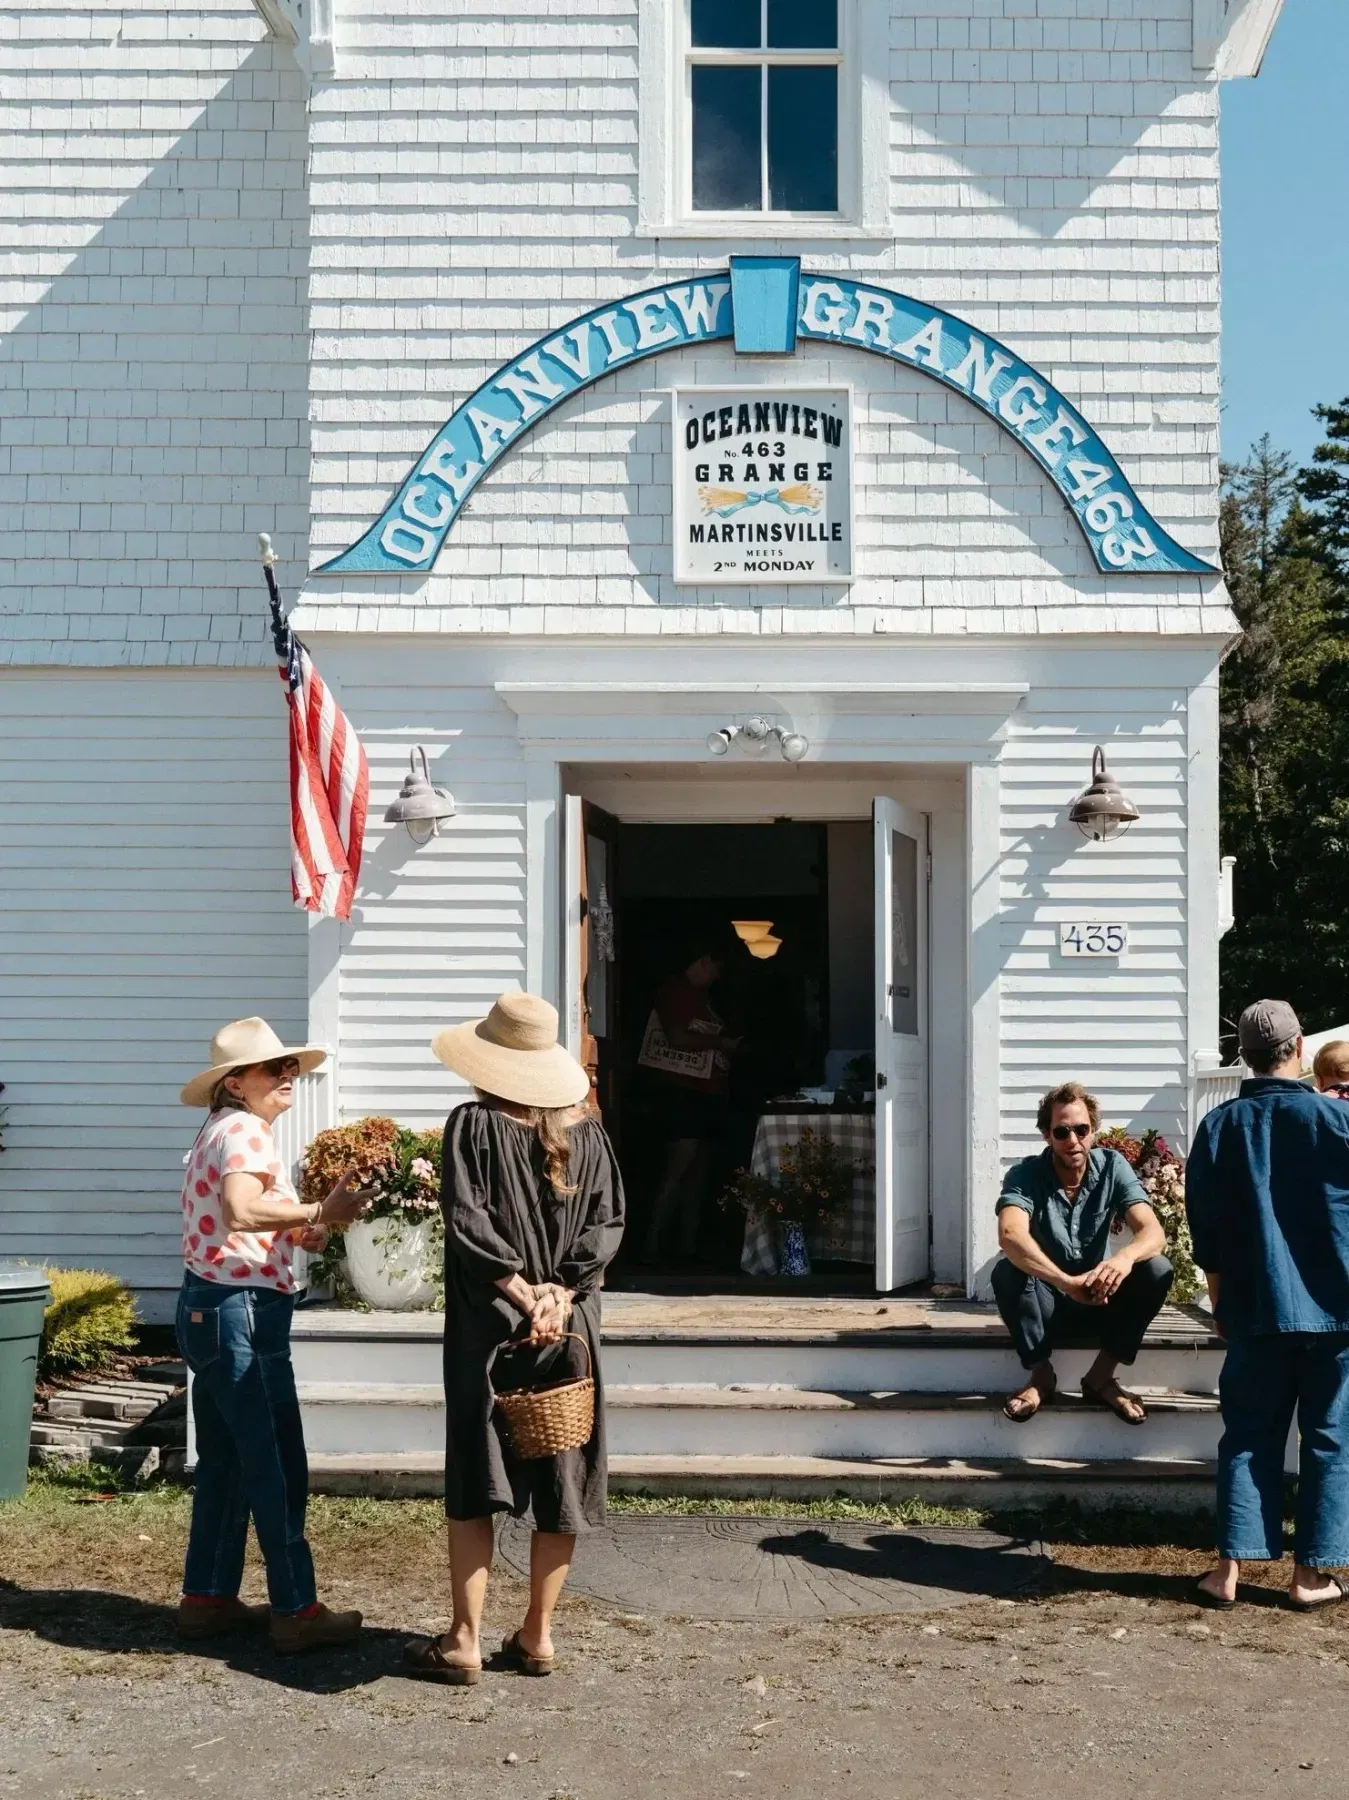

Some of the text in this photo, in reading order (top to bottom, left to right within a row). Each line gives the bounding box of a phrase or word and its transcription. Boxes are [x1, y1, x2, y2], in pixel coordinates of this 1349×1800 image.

[381, 281, 1158, 567] OCEANVIEW GRANGE 463
[686, 402, 843, 450] OCEANVIEW
[724, 442, 786, 458] No. 463
[695, 462, 833, 483] GRANGE
[689, 522, 843, 543] MARTINSVILLE
[746, 549, 784, 557] MEETS
[714, 560, 815, 572] 2ND MONDAY
[1064, 925, 1124, 953] 435
